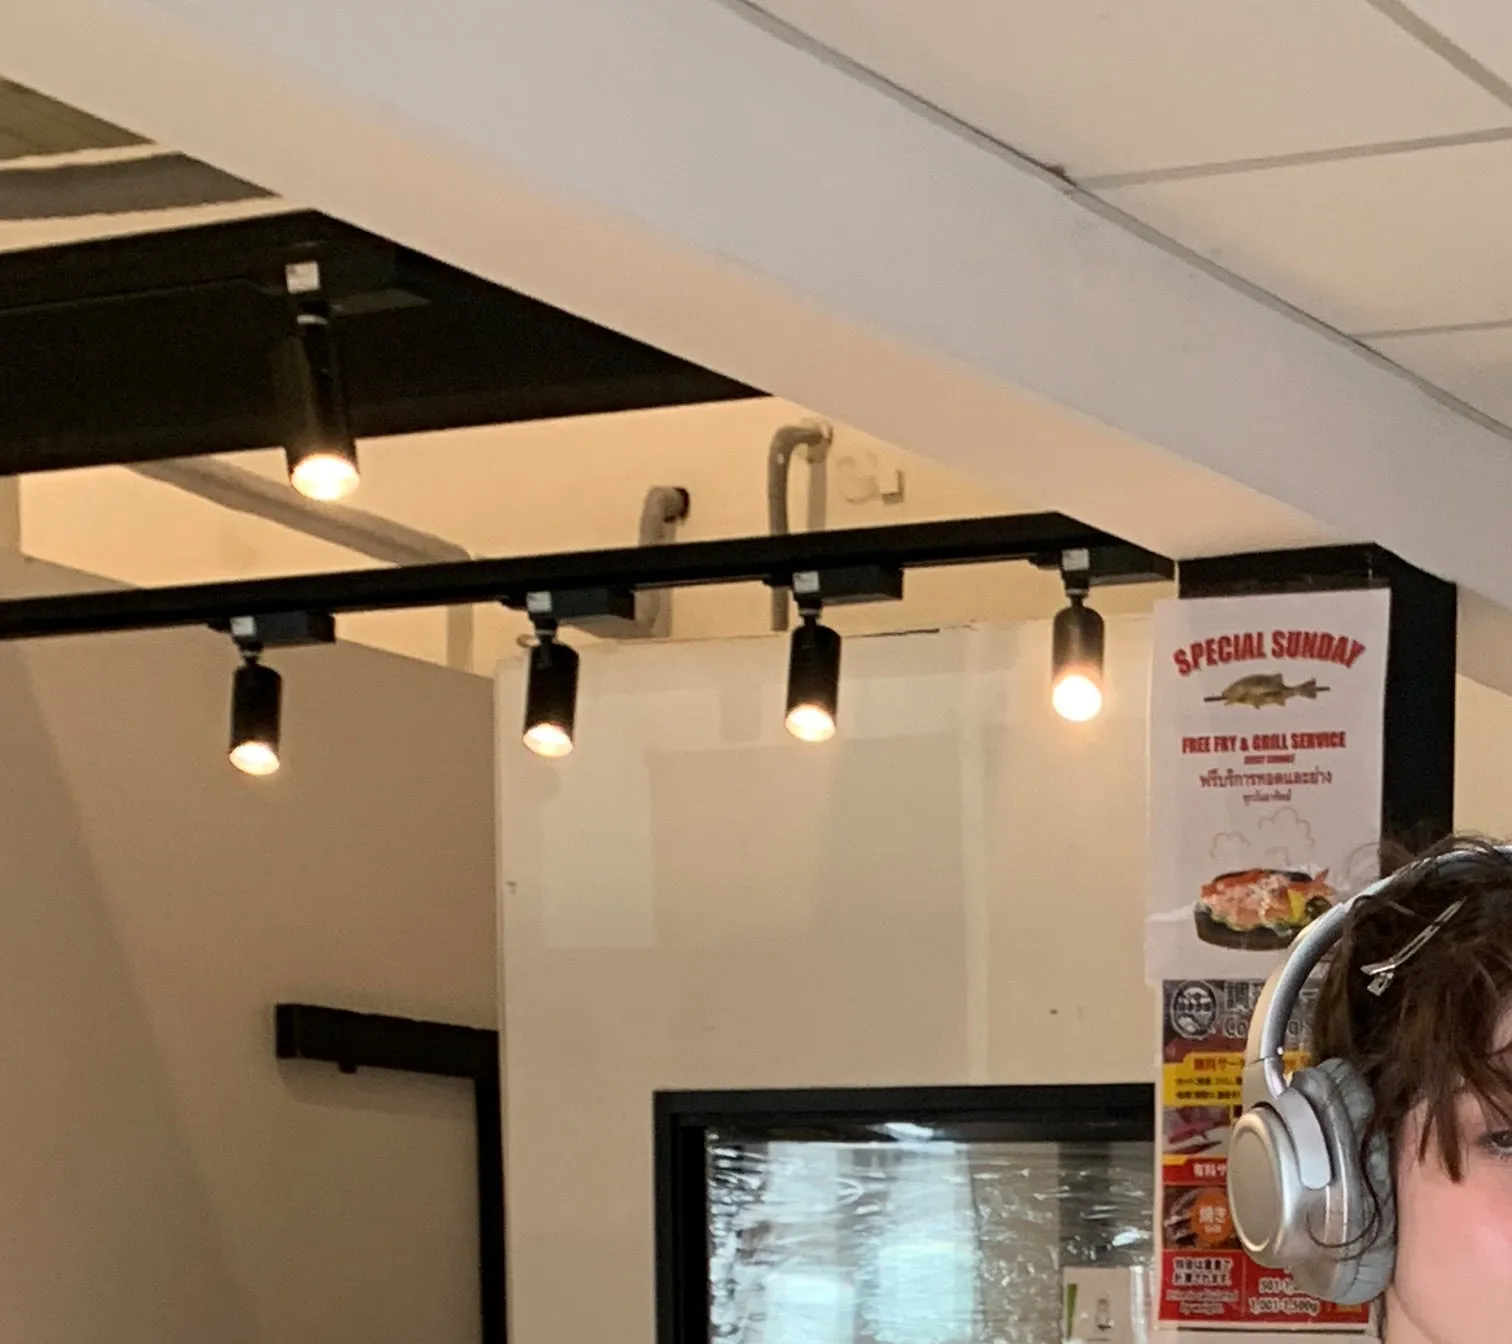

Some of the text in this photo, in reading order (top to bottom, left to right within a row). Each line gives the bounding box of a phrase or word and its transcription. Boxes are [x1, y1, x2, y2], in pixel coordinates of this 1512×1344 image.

[1172, 629, 1366, 678] SPECIAL SUNDAY
[1182, 731, 1347, 754] FREE FRY & GRILL SERVICE
